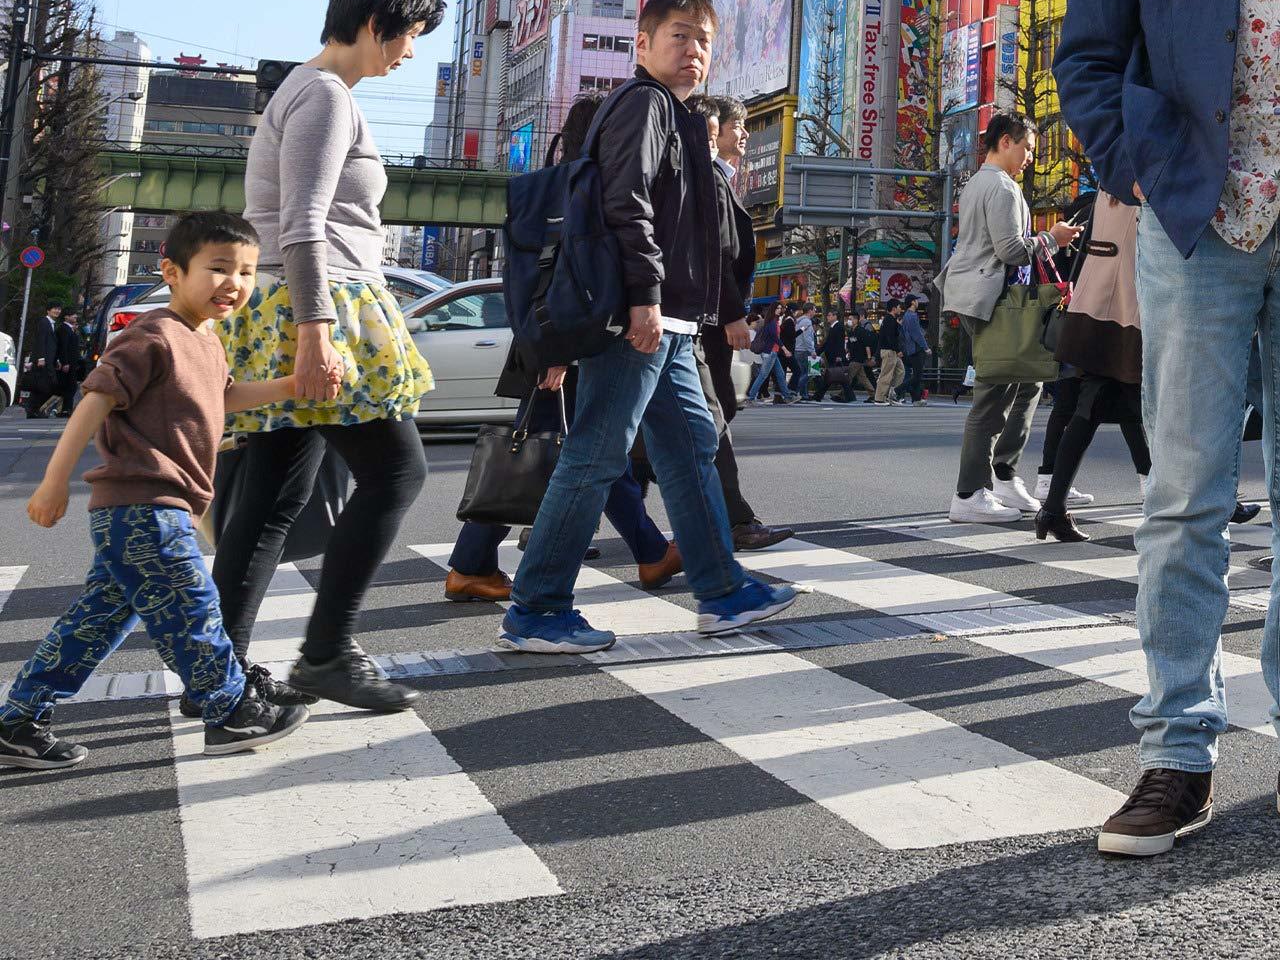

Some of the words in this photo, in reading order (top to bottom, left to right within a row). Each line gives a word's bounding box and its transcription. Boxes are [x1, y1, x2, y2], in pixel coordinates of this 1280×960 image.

[862, 20, 881, 105] Tax-free
[1002, 31, 1015, 74] SEGA
[859, 105, 878, 160] Shop
